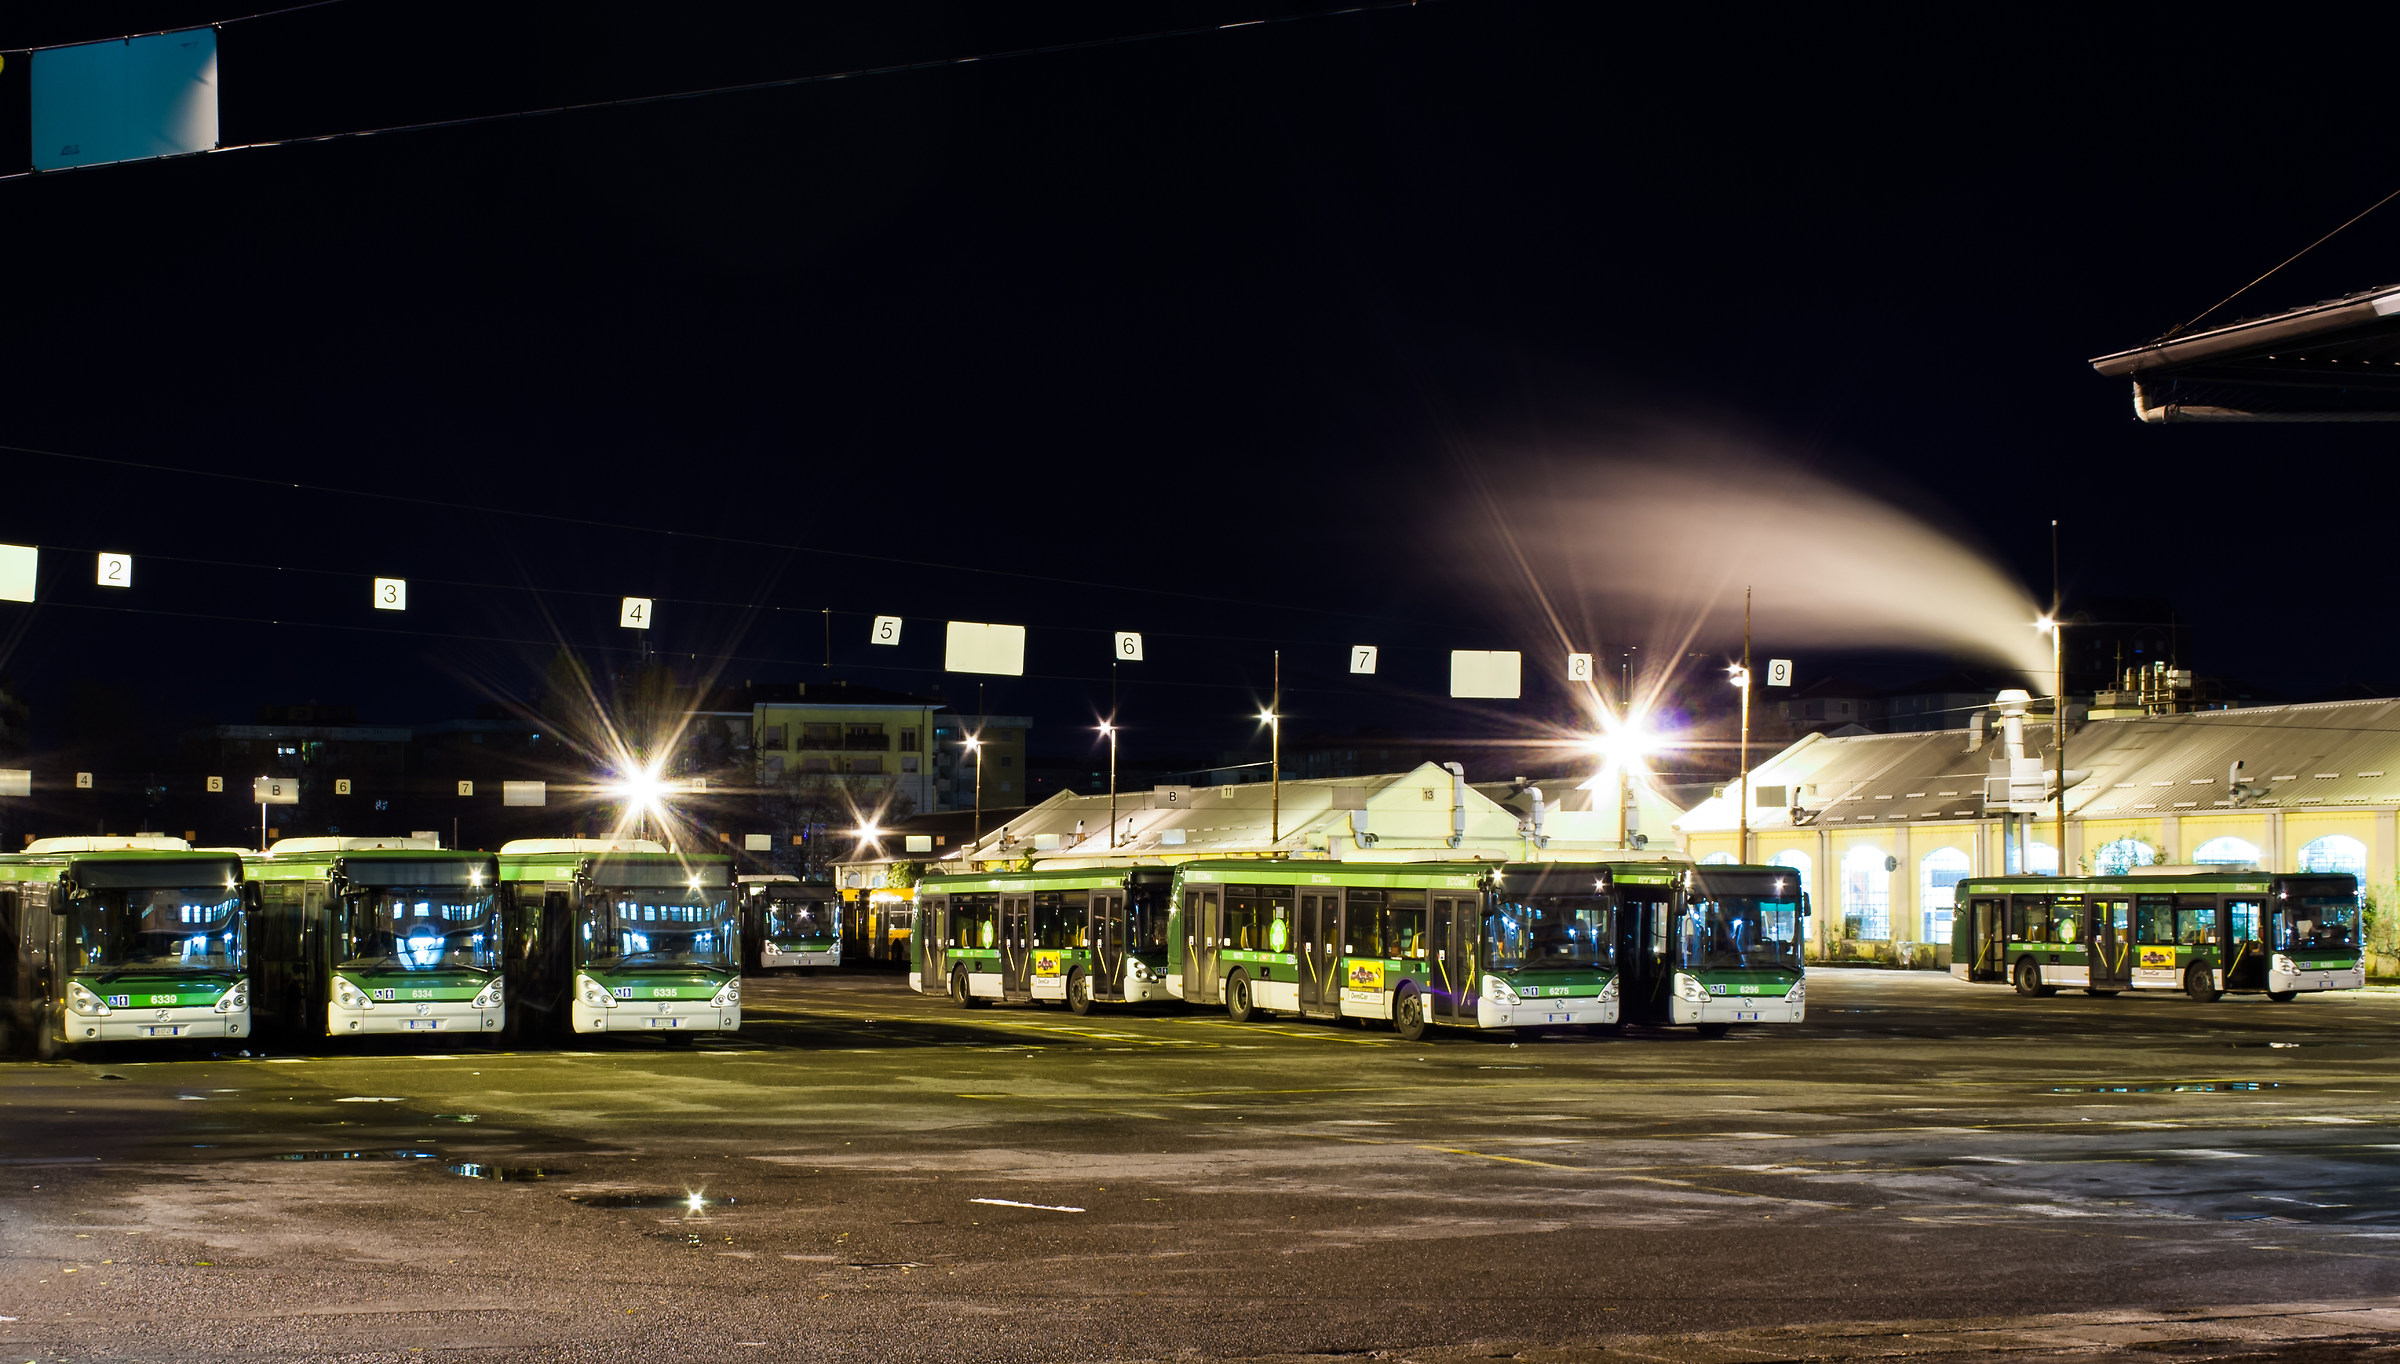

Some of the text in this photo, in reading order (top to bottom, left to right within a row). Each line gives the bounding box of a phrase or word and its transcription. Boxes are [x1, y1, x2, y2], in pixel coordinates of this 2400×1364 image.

[108, 560, 122, 580] 2
[384, 584, 397, 604] 3
[630, 604, 642, 623] 4
[880, 621, 893, 640] 5
[1123, 637, 1135, 655] 6
[1358, 651, 1370, 668] 7
[1575, 658, 1585, 676] 8
[1775, 664, 1785, 681] 9
[80, 775, 88, 786] 4
[211, 778, 219, 790] 5
[272, 784, 281, 796] B
[339, 781, 347, 792] 6
[462, 783, 470, 794] 7
[1224, 787, 1233, 797] 11
[1169, 791, 1177, 802] B
[1424, 789, 1434, 800] 13
[412, 989, 433, 998] 6334
[653, 988, 678, 997] 6335
[1549, 987, 1570, 996] 6275
[150, 994, 178, 1005] 6339
